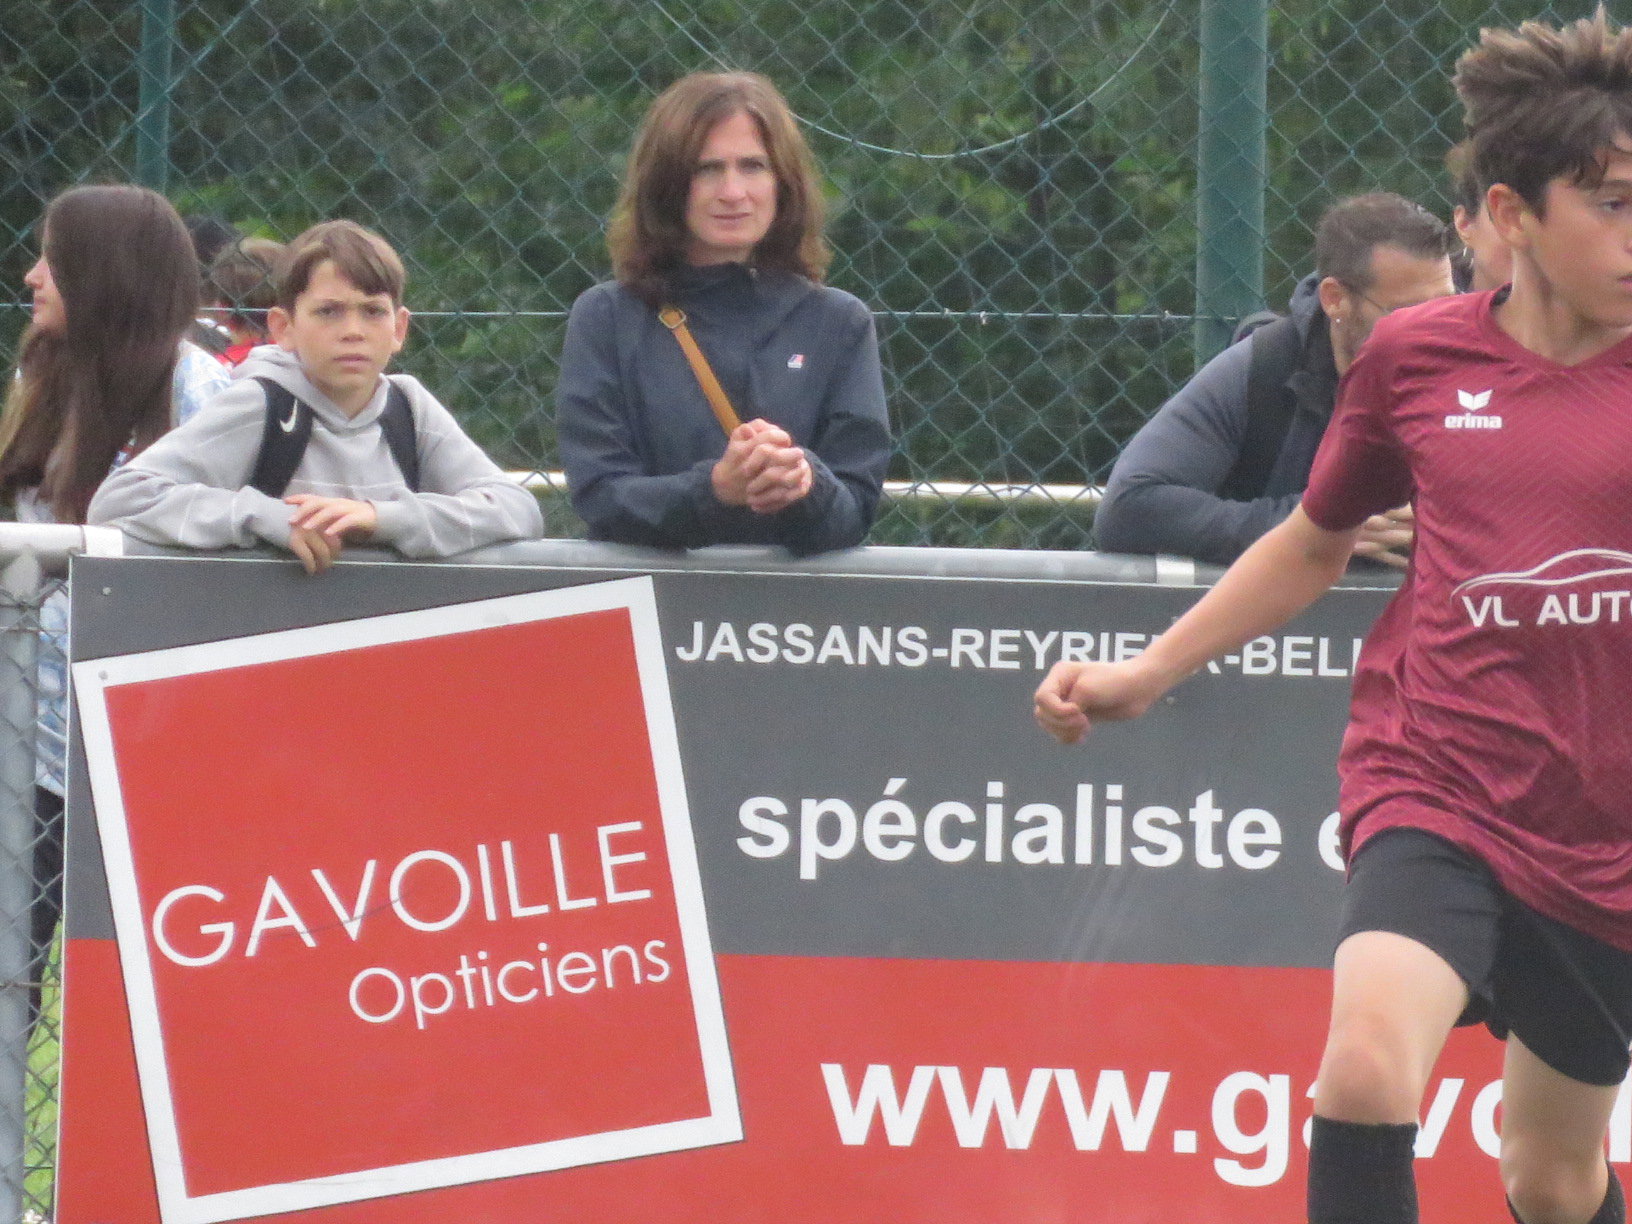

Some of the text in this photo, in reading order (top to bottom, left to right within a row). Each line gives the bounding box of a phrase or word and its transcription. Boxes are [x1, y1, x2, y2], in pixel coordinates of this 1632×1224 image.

[1444, 412, 1503, 429] erima
[1461, 595, 1520, 628] VL
[737, 777, 1283, 879] spécialiste
[152, 821, 652, 967] GAVOILLE
[348, 938, 671, 1030] Opticiens
